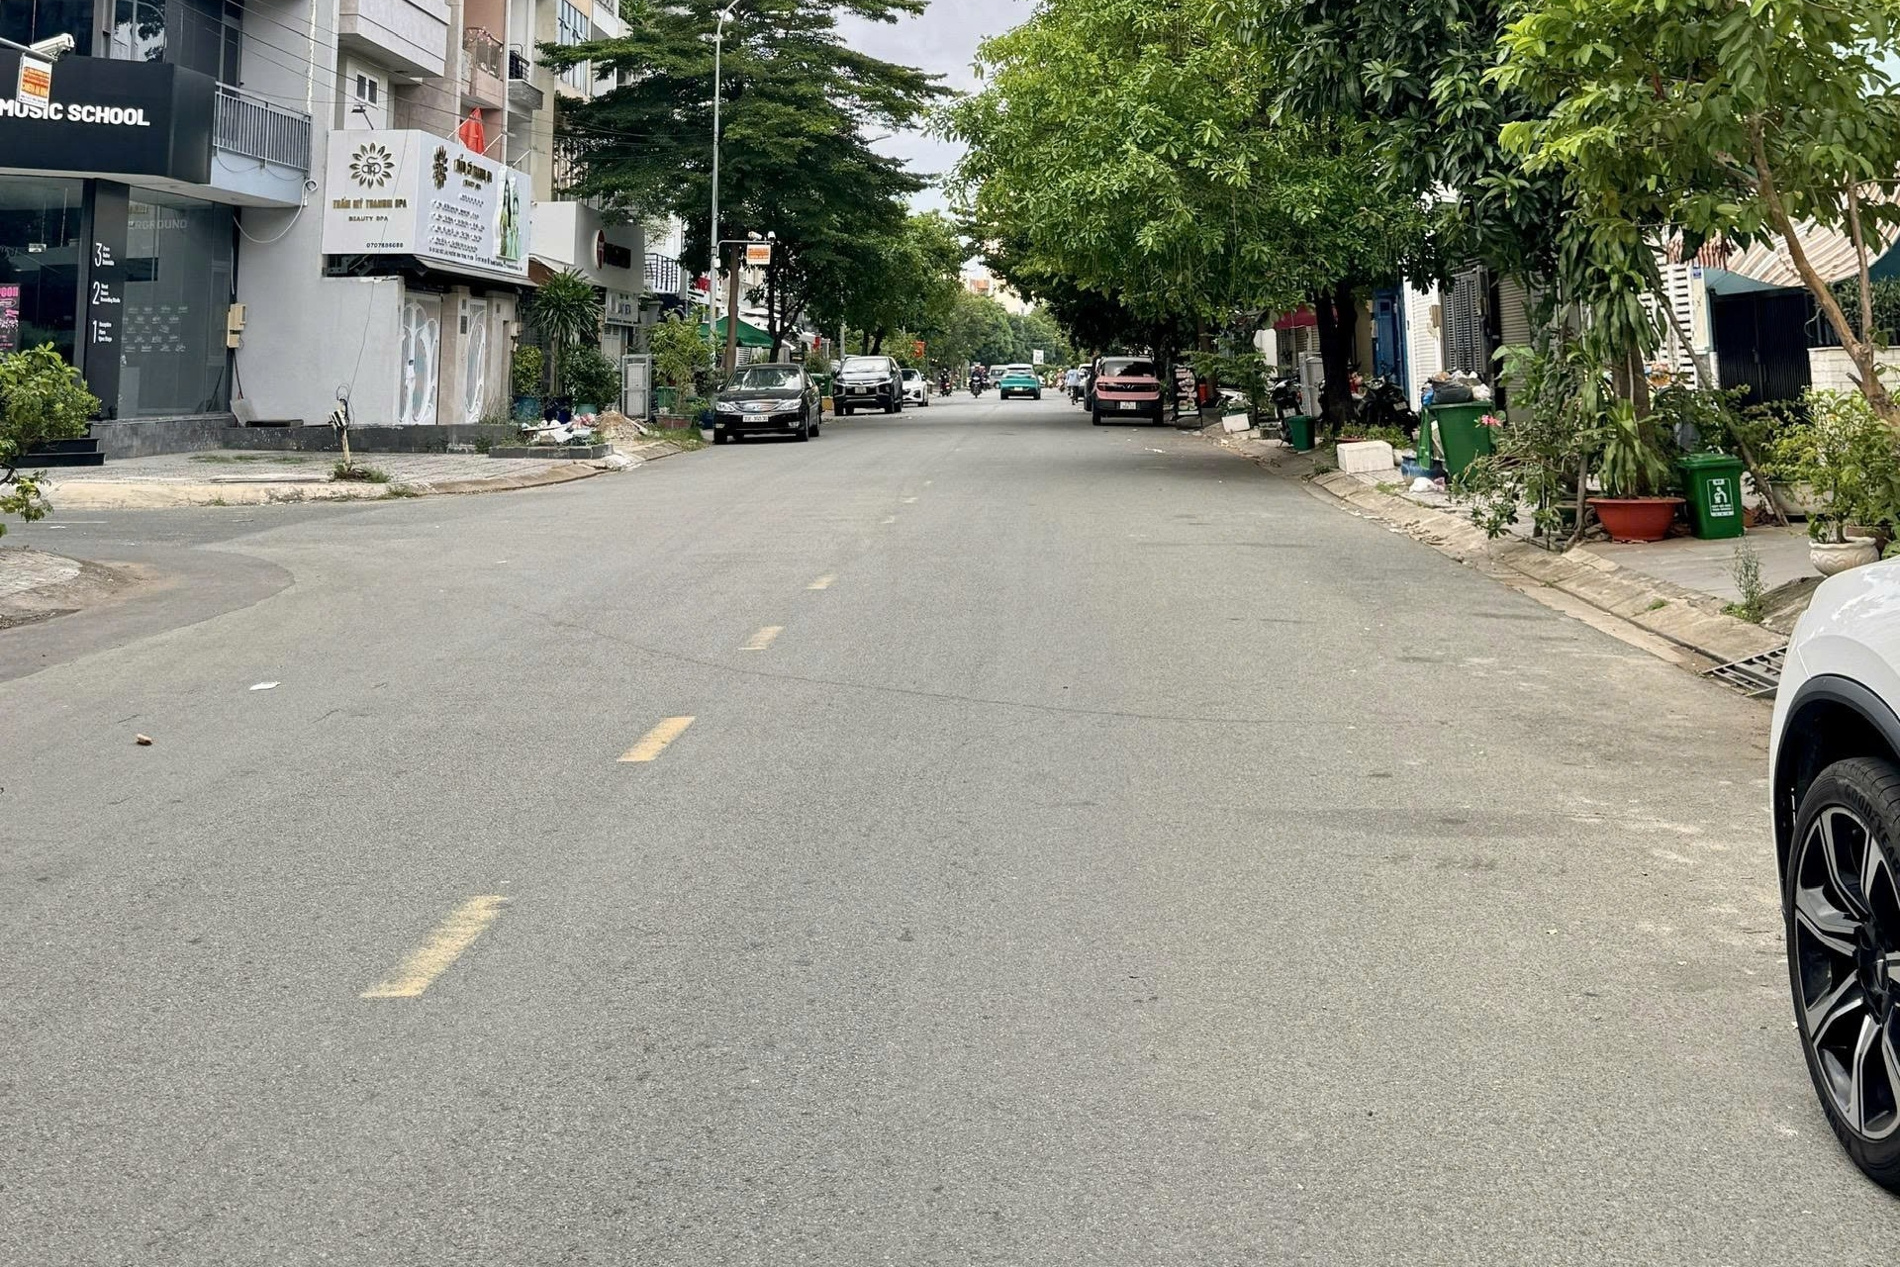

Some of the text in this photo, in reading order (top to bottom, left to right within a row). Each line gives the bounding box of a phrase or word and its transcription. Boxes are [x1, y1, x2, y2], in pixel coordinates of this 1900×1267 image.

[67, 104, 150, 126] SCHOOL
[95, 242, 103, 267] 3
[93, 281, 101, 305] 2
[92, 320, 98, 344] 1
